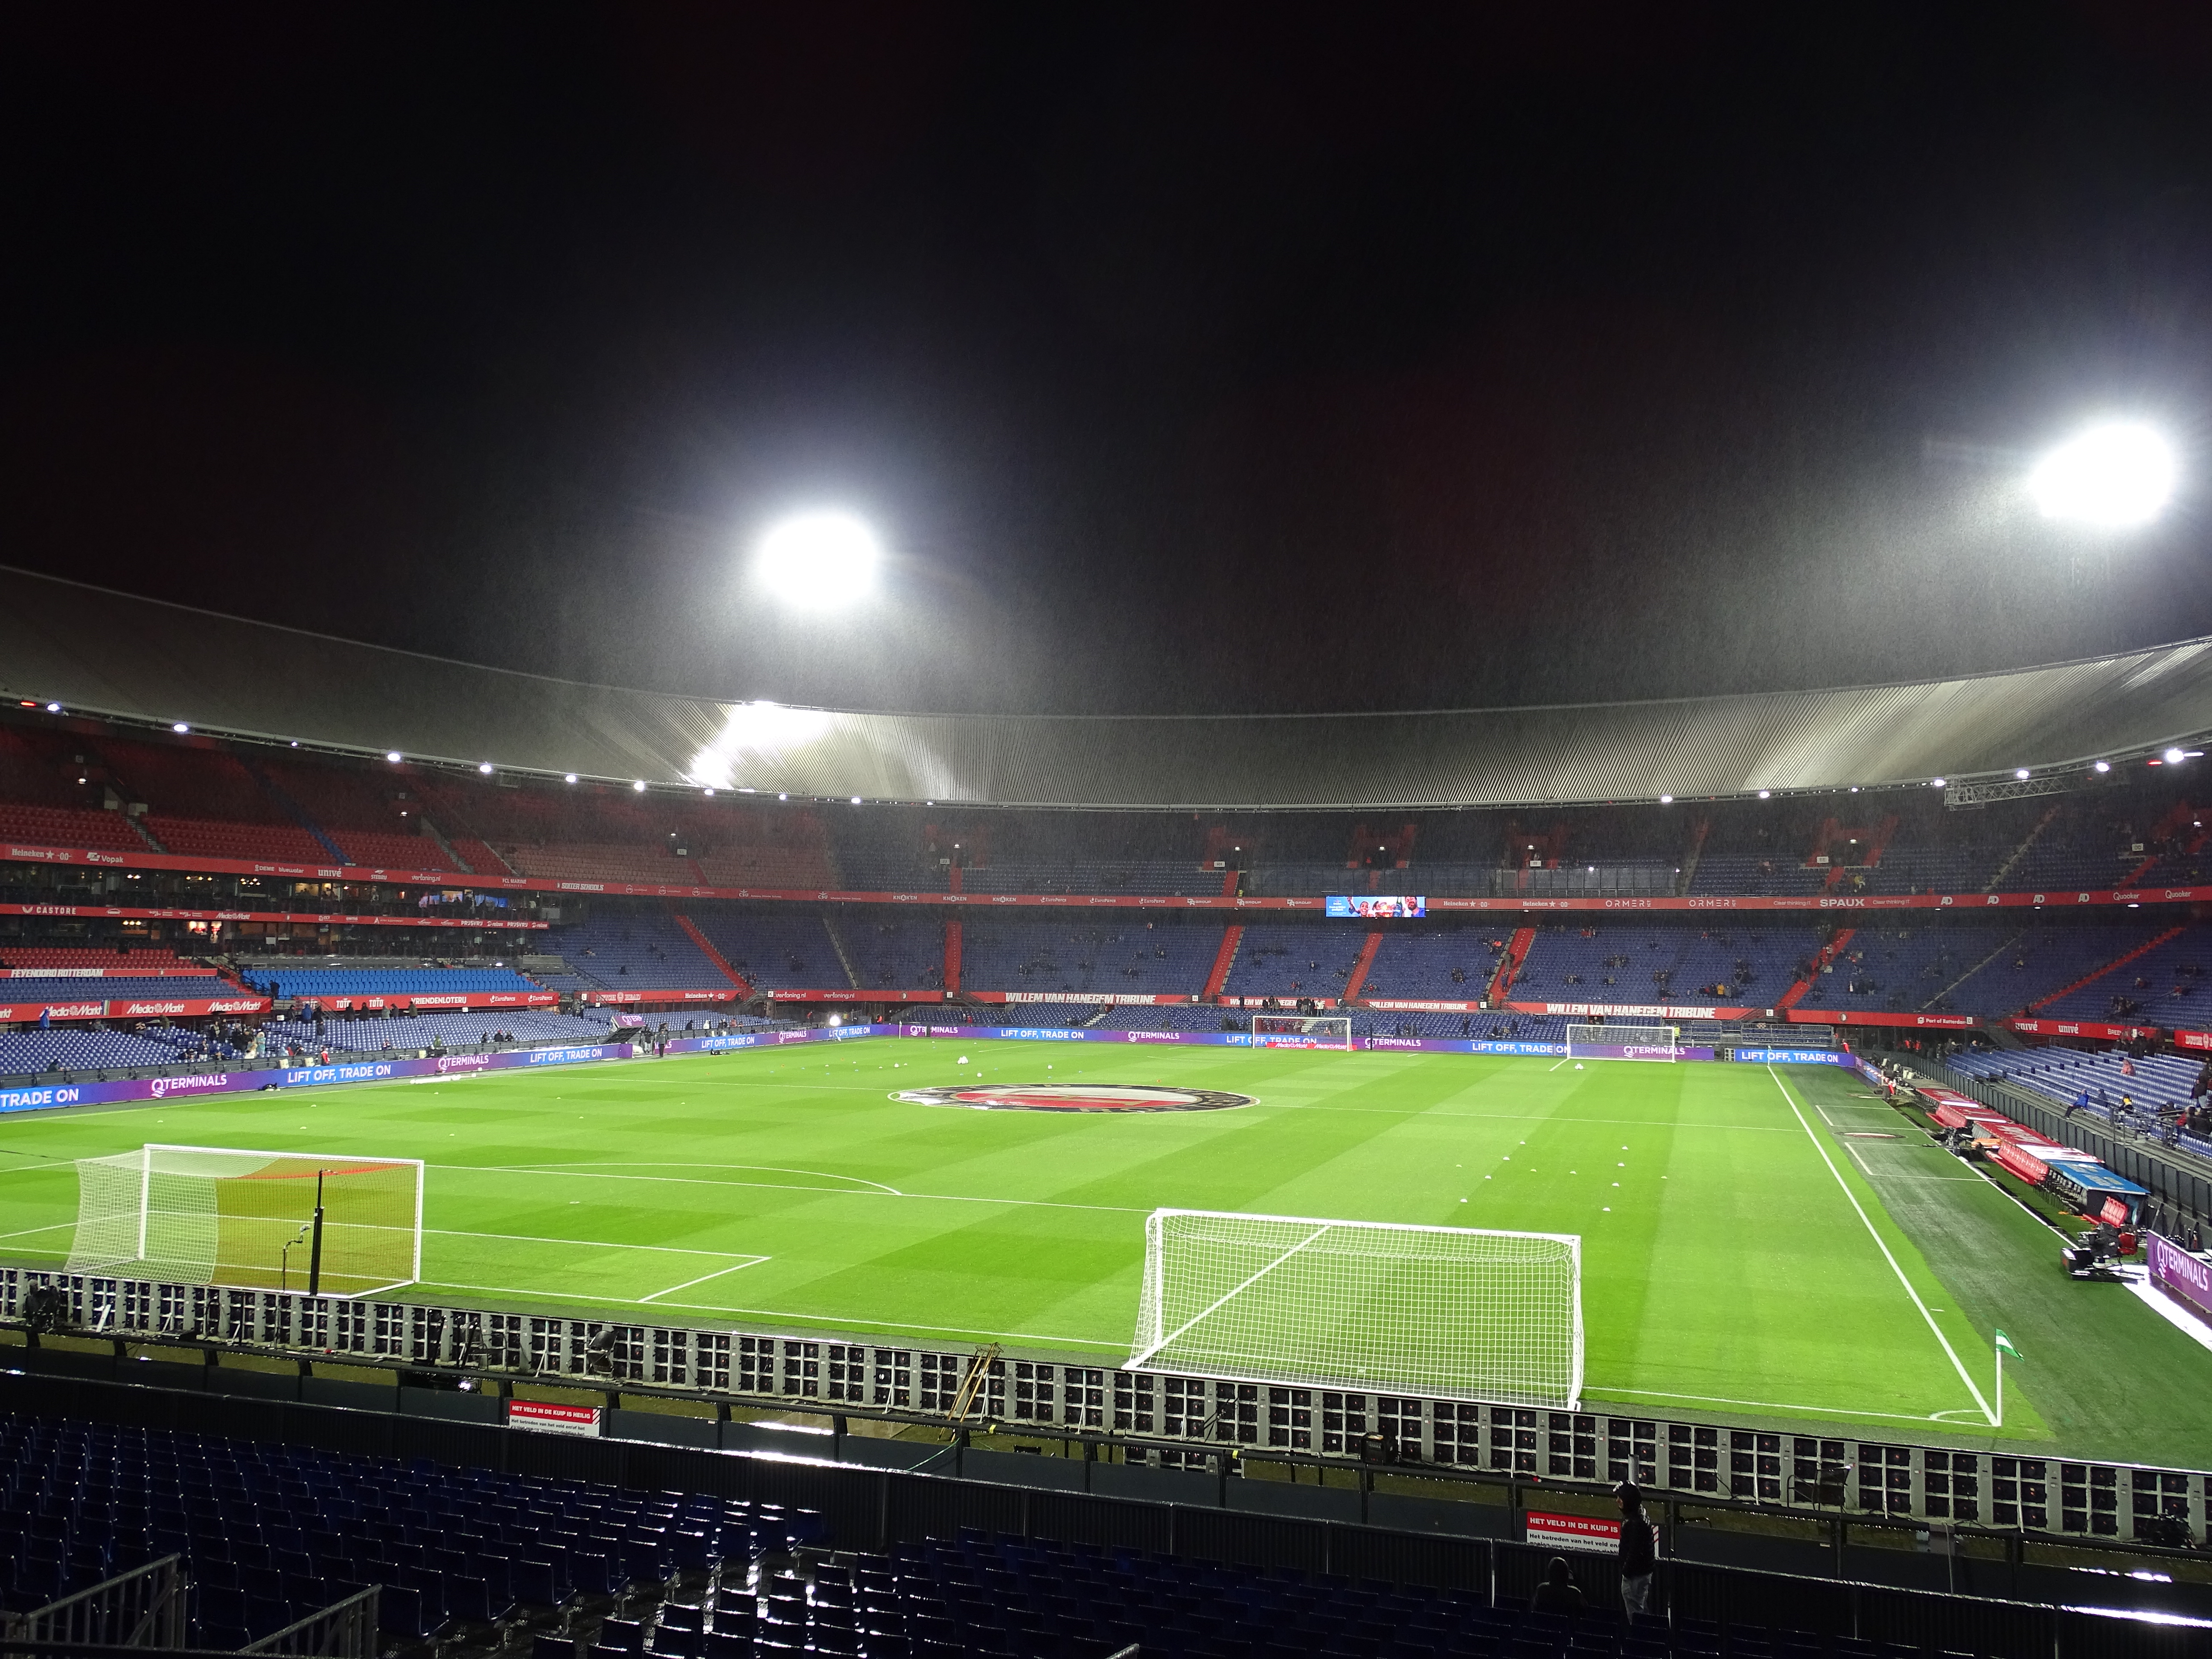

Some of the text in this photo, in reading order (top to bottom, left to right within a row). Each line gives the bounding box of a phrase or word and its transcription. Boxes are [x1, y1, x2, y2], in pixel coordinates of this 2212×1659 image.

[12, 848, 44, 858] Heineken
[102, 855, 124, 864] Vopak
[318, 867, 342, 877] univé
[2113, 892, 2139, 901] Quooker
[2165, 890, 2192, 899] Quooker
[1819, 899, 1865, 907] SPAUX
[36, 906, 76, 914] CASTORE
[11, 969, 104, 977] FEYENOORD ROTTERDAM
[411, 996, 467, 1005] VRIENDENLOTERIJ
[1005, 993, 1157, 1004] WILLEM VAN HANEGEM TRIBUNE
[126, 1003, 185, 1014] Media Markt
[207, 1001, 262, 1012] Media Markt
[1369, 1001, 1394, 1009] WILLEM
[1546, 1004, 1716, 1019] WILLEM VAN HANEGEM TRIBUNE
[2058, 1023, 2079, 1034] univé
[779, 1030, 807, 1043] QTERMINALS
[1128, 1031, 1180, 1042] QTERMINALS
[701, 1036, 755, 1049] LIFT OFF, TRADE ON
[1472, 1043, 1571, 1054] LIFT OFF, TRADE ON
[1624, 1046, 1685, 1058] QTERMINALS
[530, 1048, 602, 1063] LIFT OFF, TRADE ON
[1741, 1052, 1839, 1063] LIFT OFF, TRADE ON
[438, 1054, 489, 1073] QTERMINALS
[287, 1064, 392, 1083] LIFT OFF, TRADE ON
[151, 1074, 227, 1098] QTERMINALS
[0, 1088, 79, 1108] TRADE ON
[2157, 1240, 2209, 1292] QTERMINALS
[1546, 1519, 1566, 1527] VELD
[1590, 1524, 1609, 1532] KUIP
[1542, 1534, 1569, 1543] betreden
